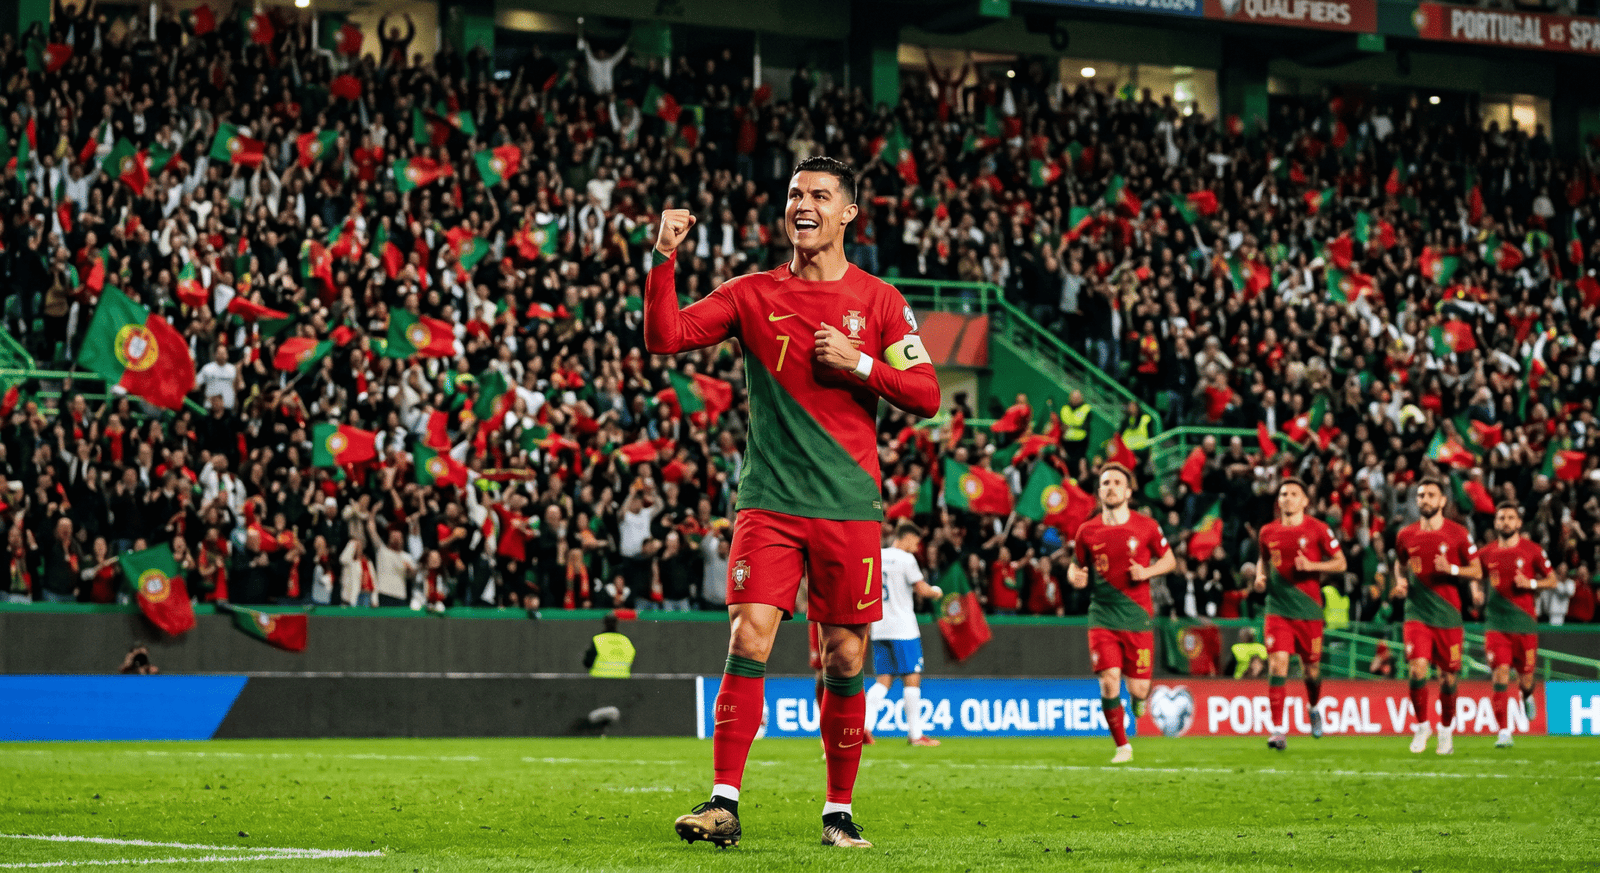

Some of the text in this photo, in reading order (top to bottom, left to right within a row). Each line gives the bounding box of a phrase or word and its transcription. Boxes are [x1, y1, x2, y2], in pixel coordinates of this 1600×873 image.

[1244, 0, 1350, 25] QUALIFIERS
[1451, 9, 1544, 46] PORTUGAL
[776, 335, 790, 372] 7
[903, 344, 918, 360] C
[862, 557, 874, 595] 7
